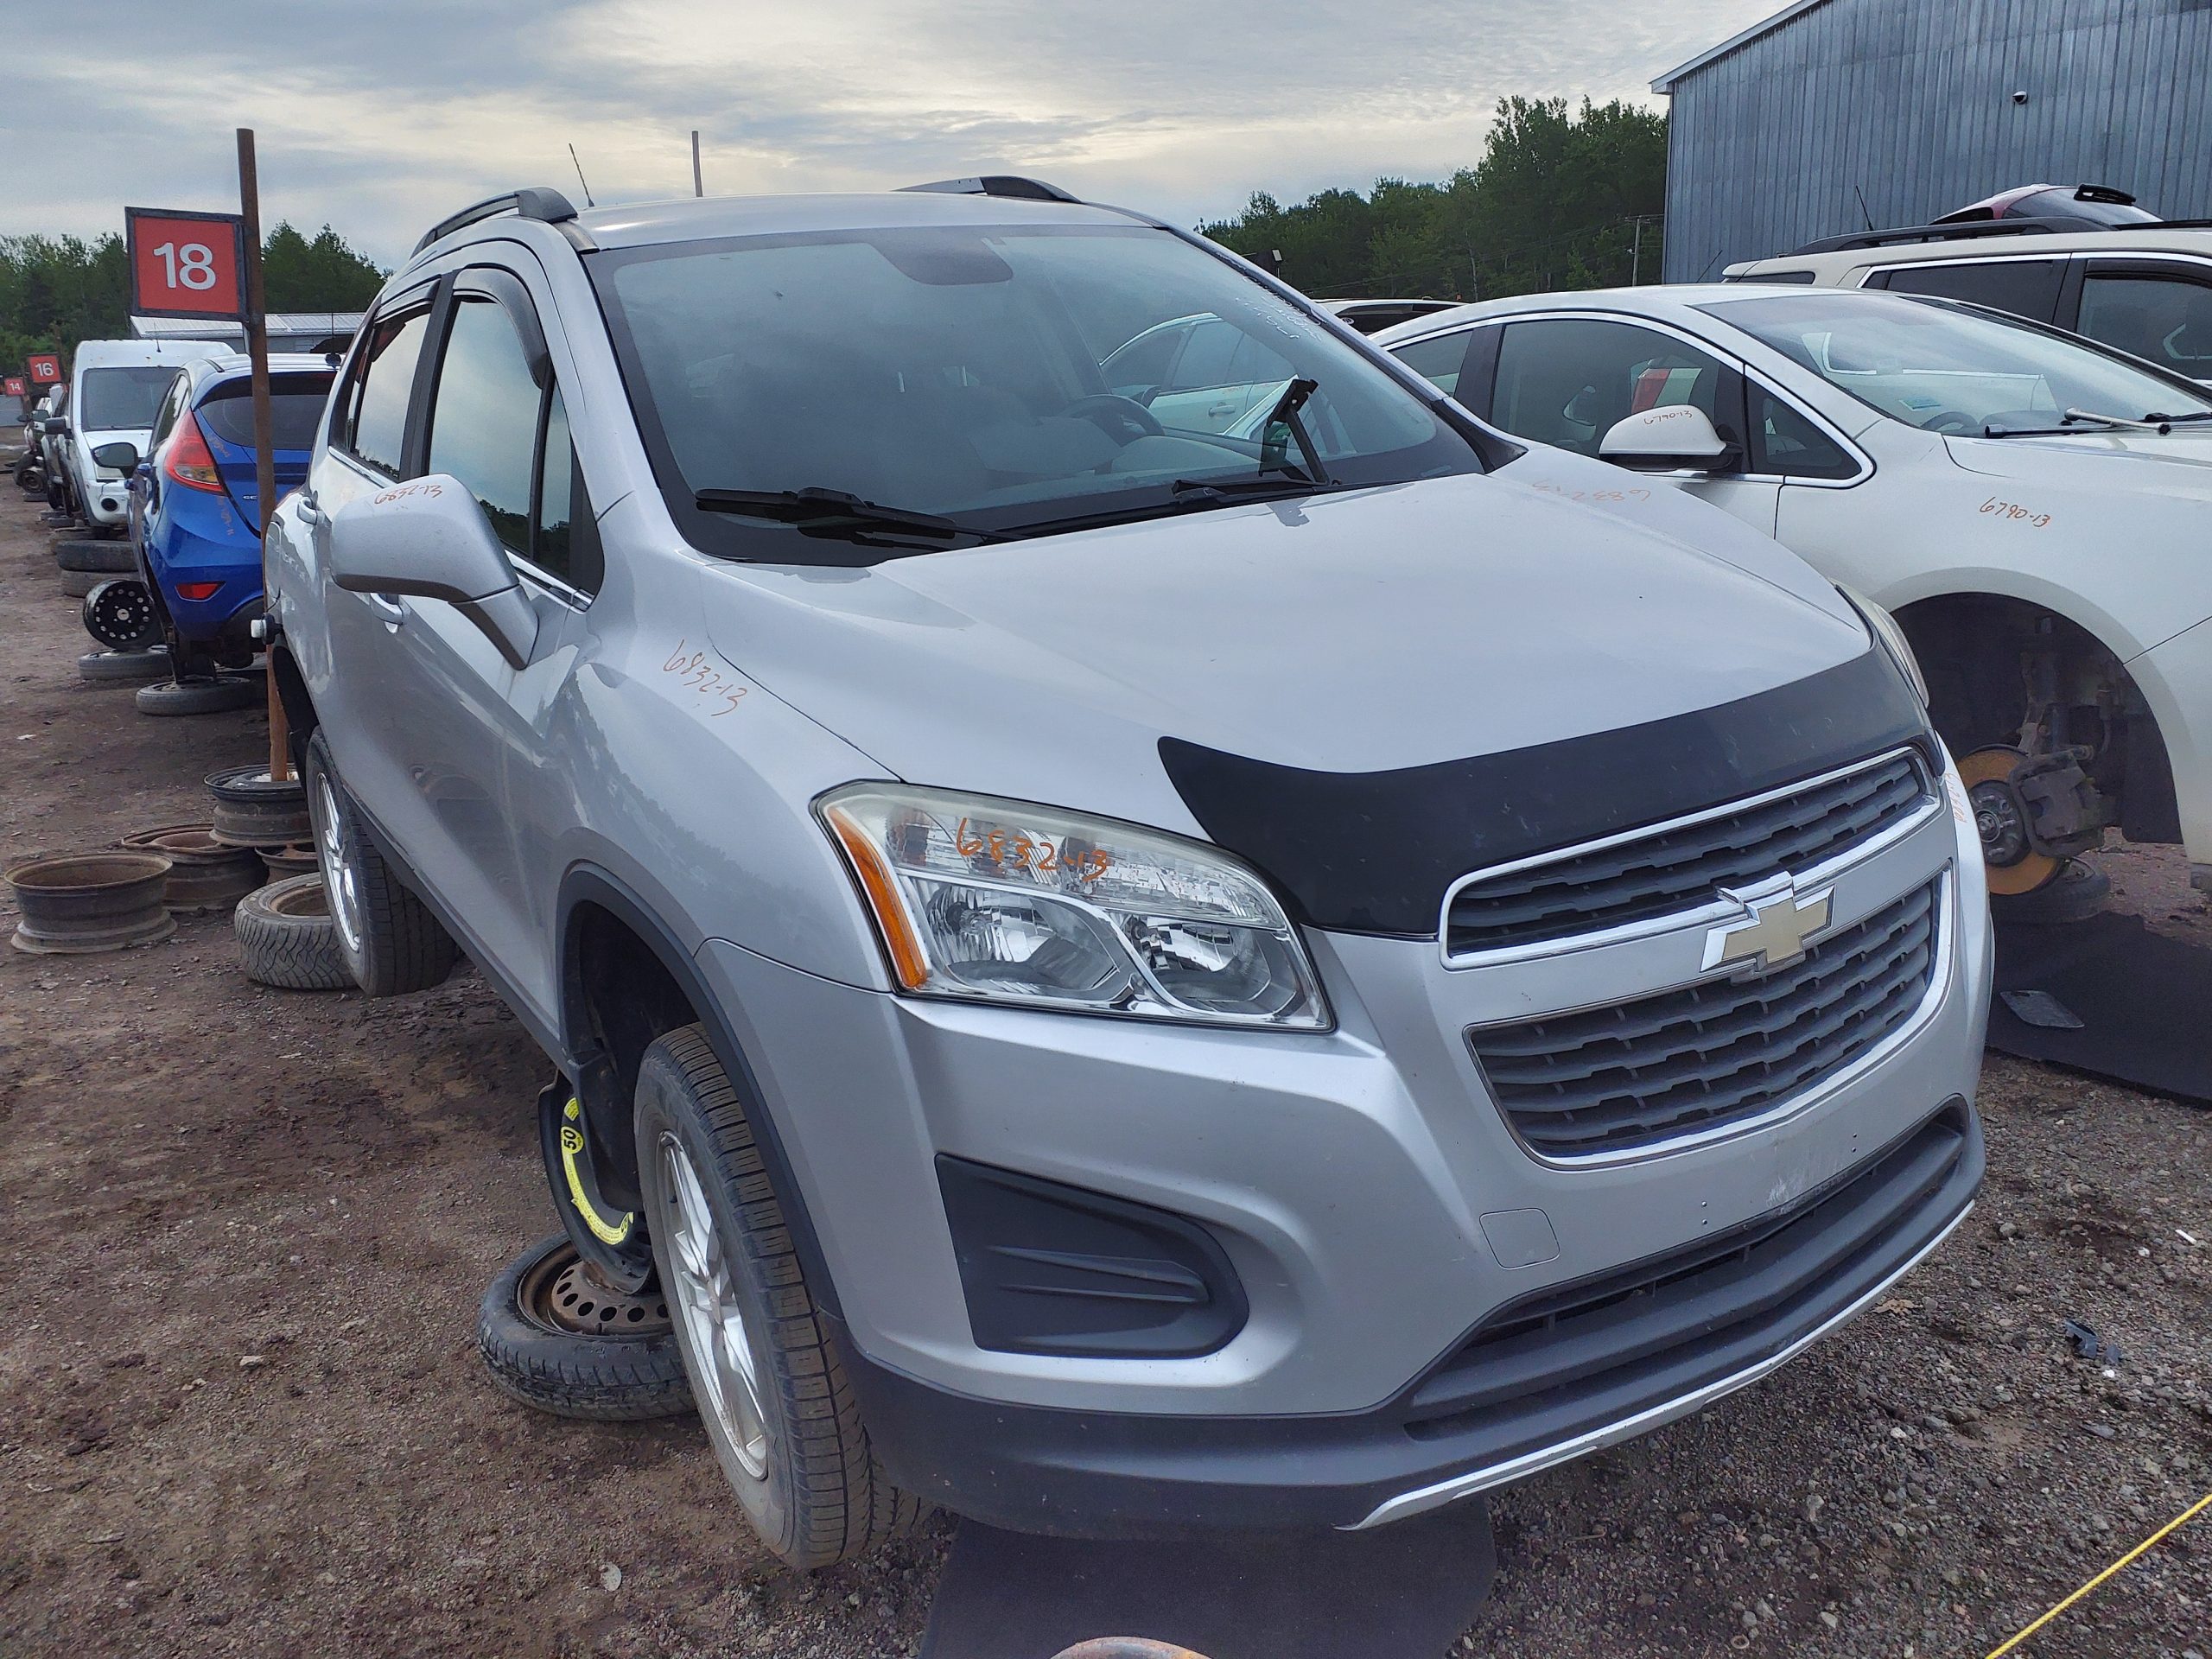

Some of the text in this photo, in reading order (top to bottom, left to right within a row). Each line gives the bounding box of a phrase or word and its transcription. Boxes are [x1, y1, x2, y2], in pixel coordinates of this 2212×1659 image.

[153, 242, 216, 289] 18
[35, 362, 54, 377] 16
[10, 382, 21, 391] 14
[1979, 496, 2051, 528] 6790-13
[663, 639, 747, 717] 6832-13
[956, 817, 1108, 882] 6832-13
[563, 1128, 577, 1151] 50
